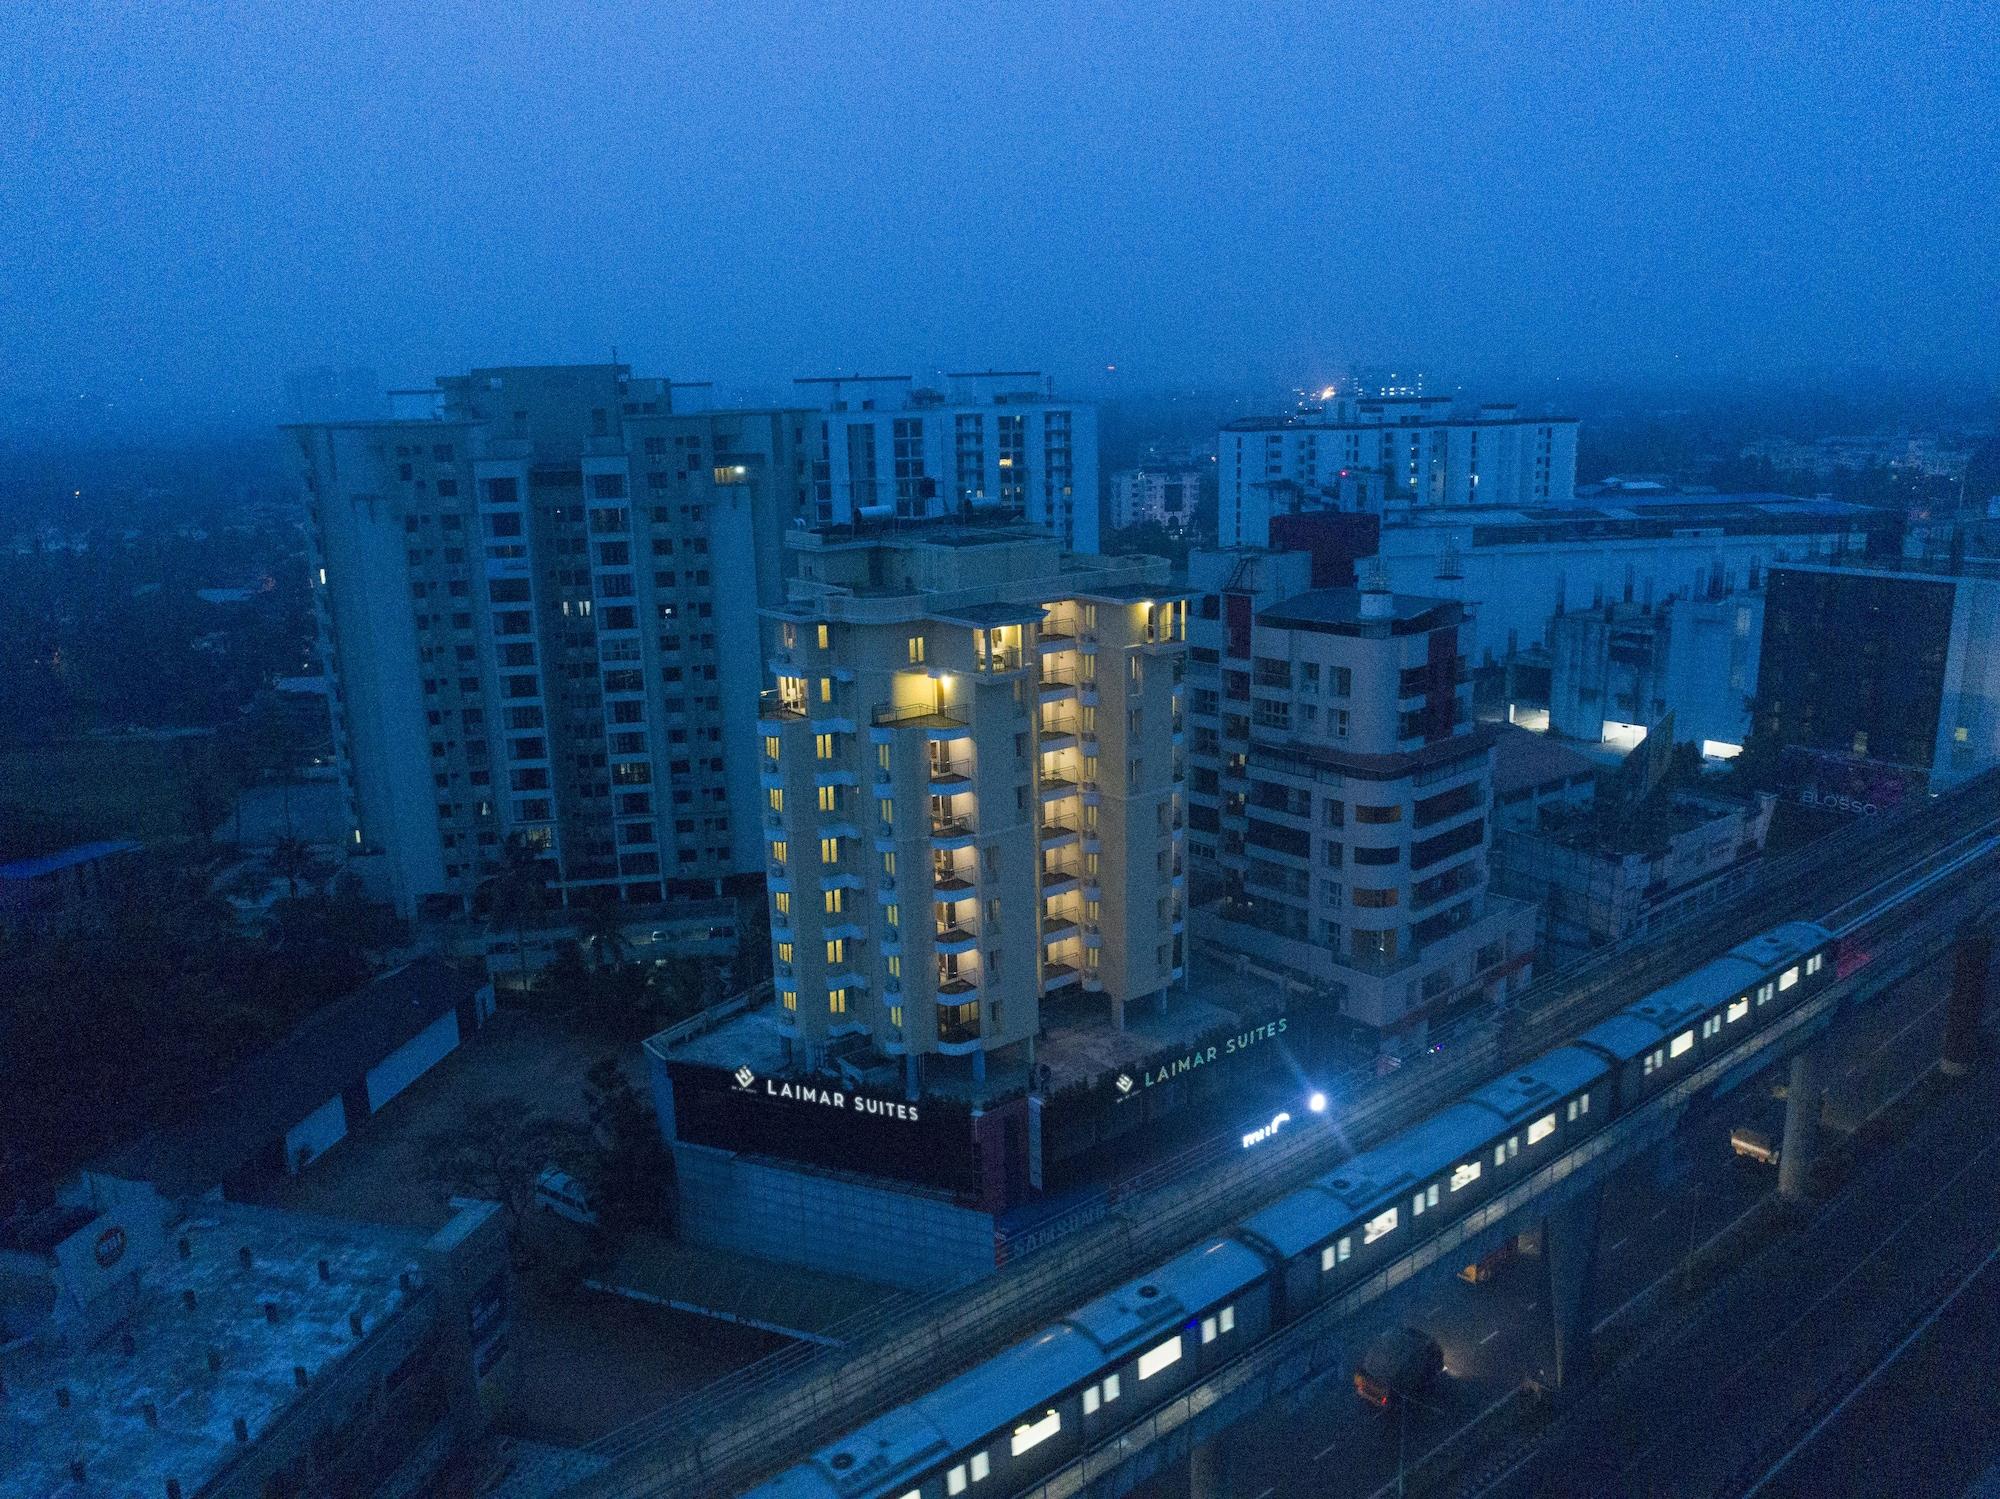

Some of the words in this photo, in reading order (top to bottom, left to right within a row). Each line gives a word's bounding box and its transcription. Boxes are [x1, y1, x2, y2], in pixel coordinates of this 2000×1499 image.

[1144, 1046, 1217, 1088] LAIMAR
[1226, 1017, 1288, 1054] SUITES
[766, 1079, 845, 1108] LAIMAR
[854, 1096, 920, 1122] SUITES
[1013, 1204, 1106, 1258] SAMSUNG
